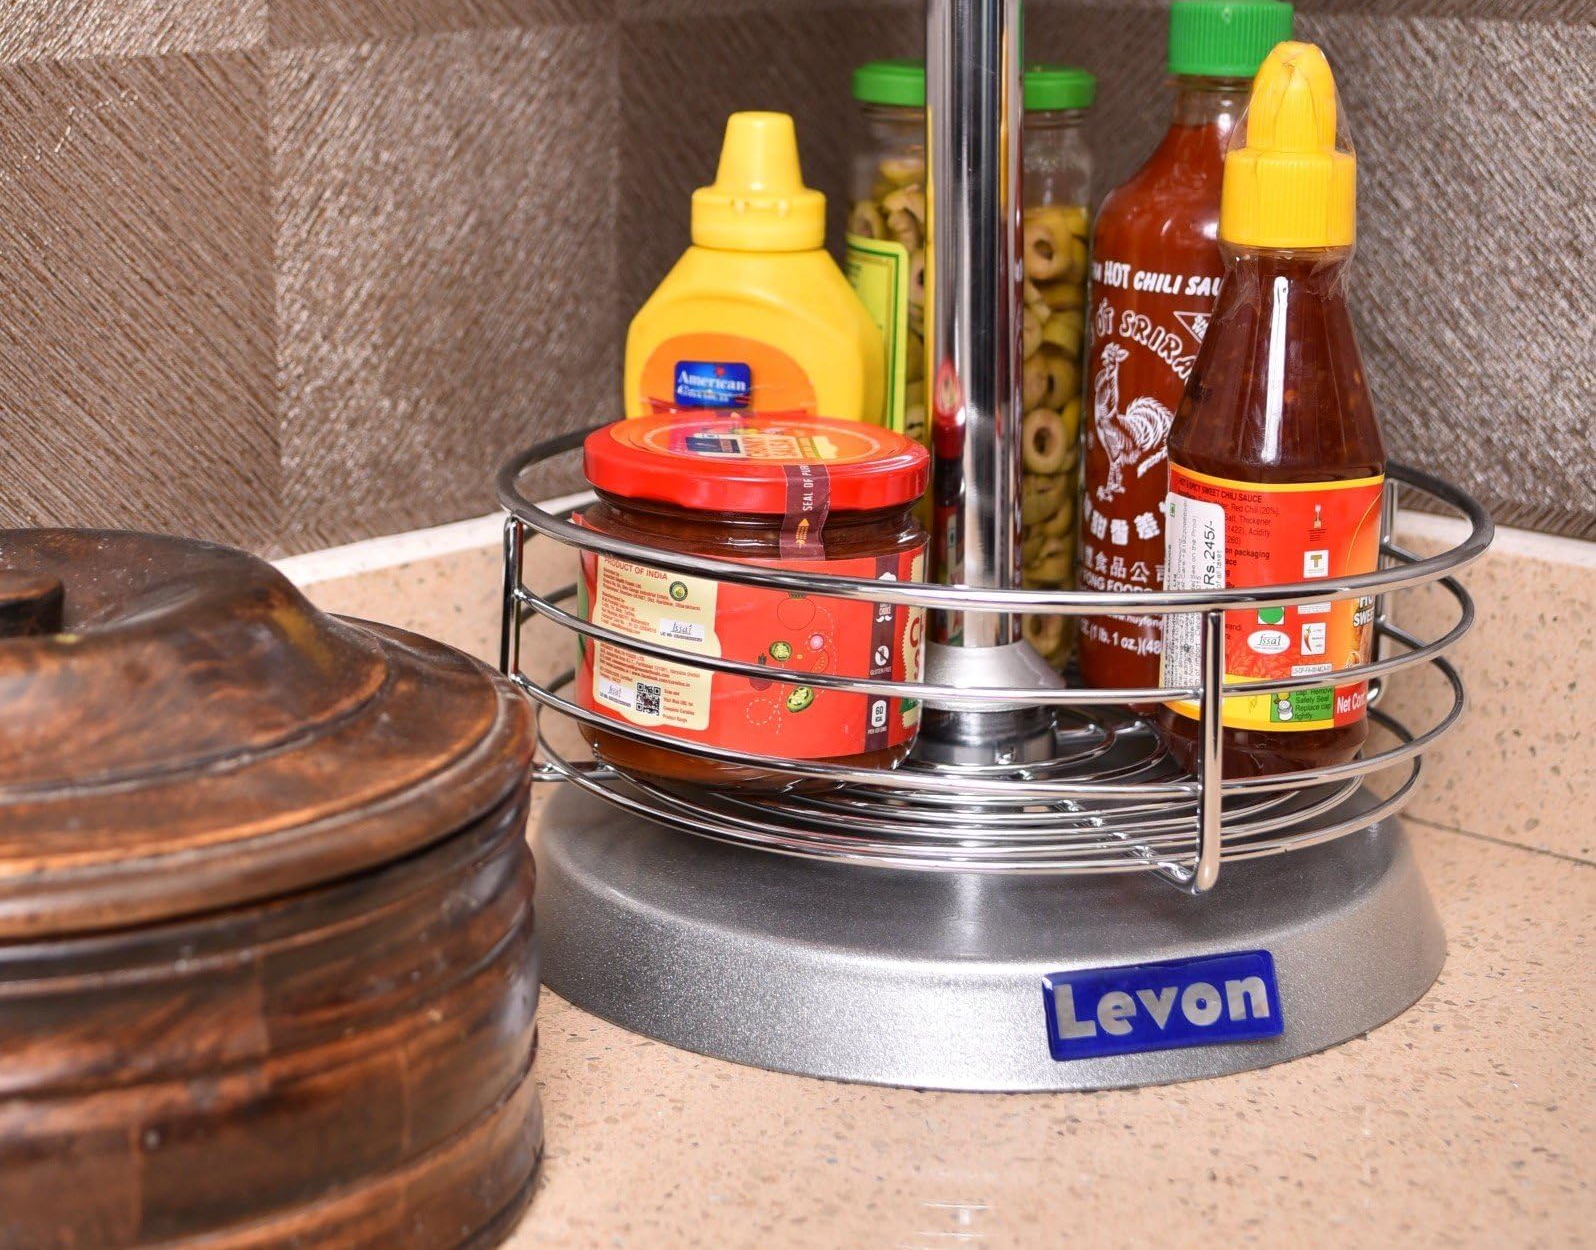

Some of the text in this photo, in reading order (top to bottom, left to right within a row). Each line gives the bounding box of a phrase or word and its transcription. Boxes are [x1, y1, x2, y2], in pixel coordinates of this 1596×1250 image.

[1104, 260, 1132, 290] HOT
[1133, 270, 1183, 295] CHILI
[1185, 275, 1223, 297] SAU
[1119, 309, 1197, 384] SRIRA
[678, 370, 746, 392] American
[677, 384, 730, 403] Garden
[803, 478, 814, 488] OF
[802, 492, 814, 512] SEAL
[1202, 486, 1221, 498] SWEET
[1238, 494, 1263, 504] SAUCE
[1231, 504, 1244, 512] Red
[1240, 516, 1272, 526] Thickener
[1202, 520, 1216, 586] Rs.245/-
[1234, 548, 1271, 560] packaging
[604, 556, 668, 581] PRODUCT OF INDIA
[1354, 606, 1375, 627] SWE
[870, 666, 892, 676] GLUTEN FREE
[1296, 695, 1330, 705] Safety Seal
[1296, 703, 1332, 713] Replace cap
[1336, 696, 1352, 714] Net
[876, 705, 885, 716] 60
[1294, 712, 1313, 721] tightly
[1053, 975, 1270, 1040] Levon
